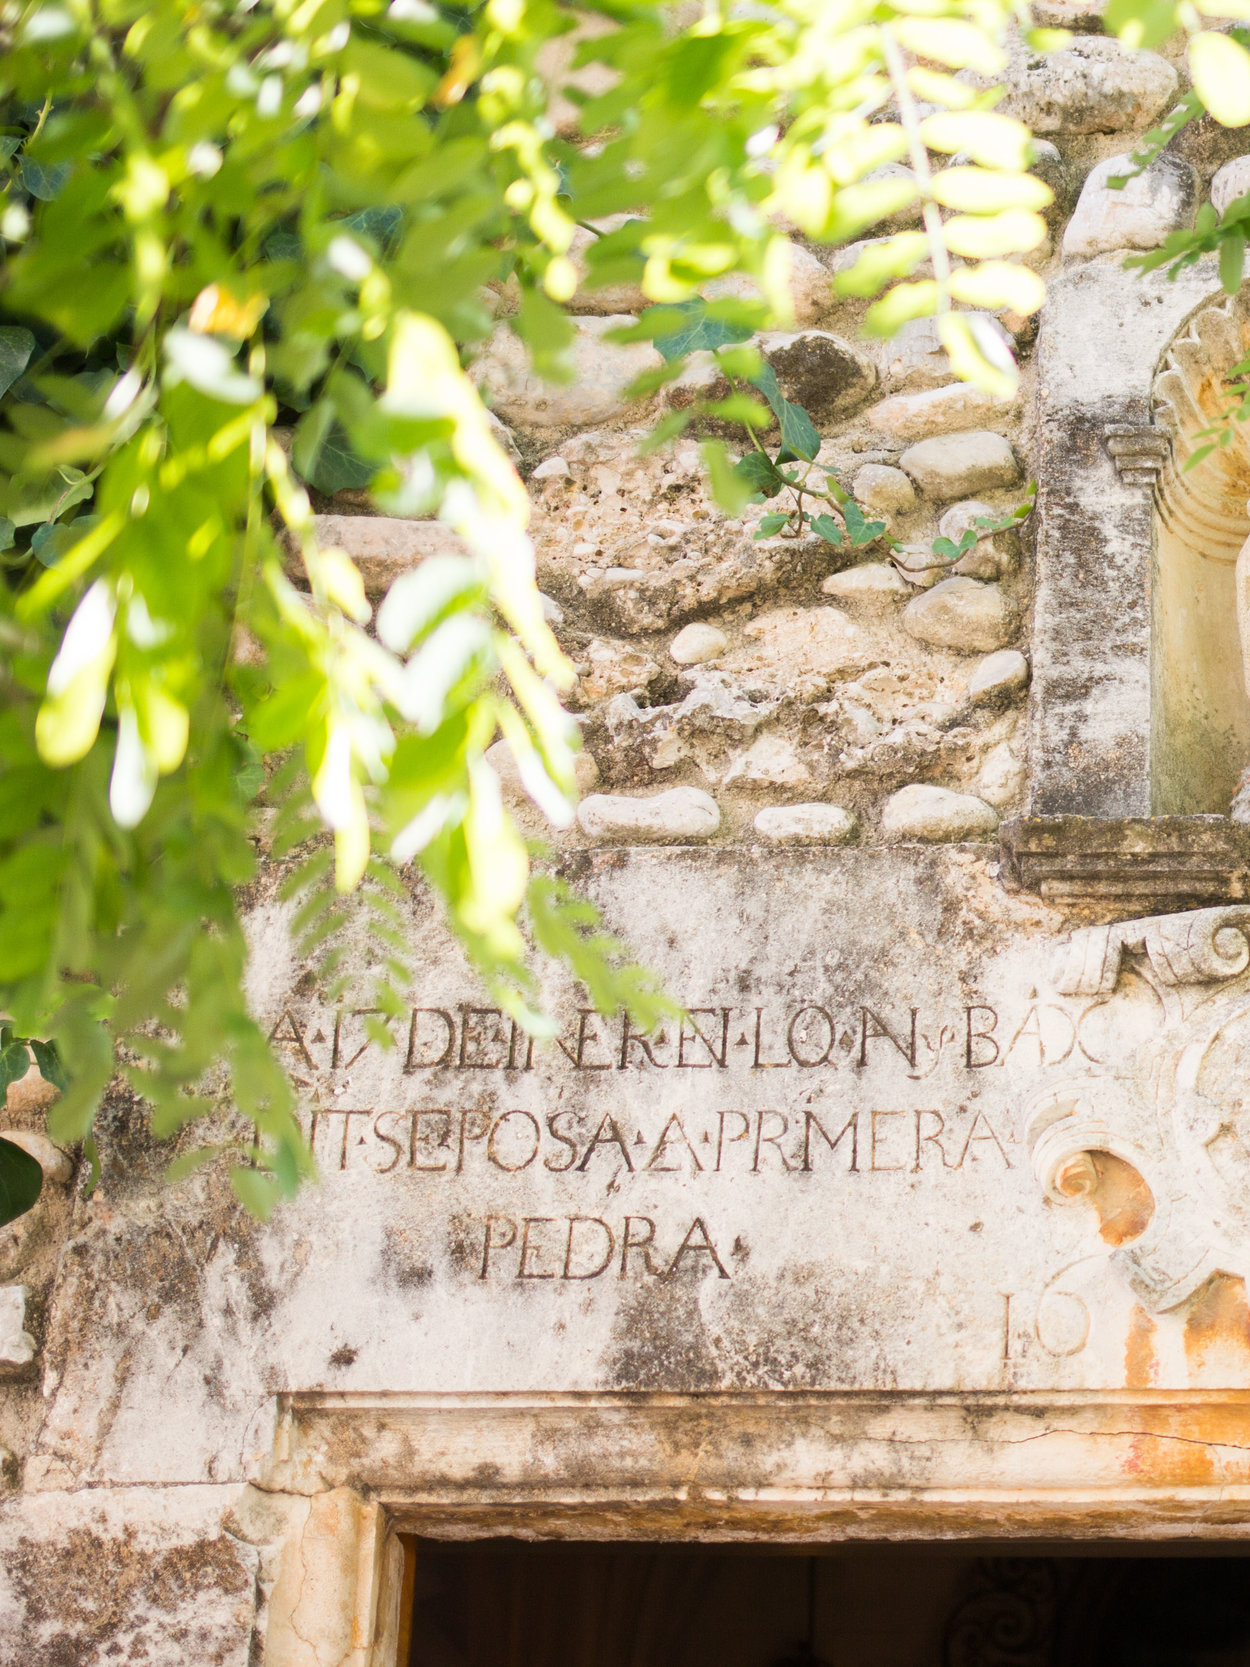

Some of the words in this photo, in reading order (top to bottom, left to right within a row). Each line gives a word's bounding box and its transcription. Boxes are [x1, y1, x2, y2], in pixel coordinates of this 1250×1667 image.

[402, 1003, 503, 1075] DE
[366, 1107, 449, 1174] SE
[450, 1107, 637, 1176] POSA
[477, 1212, 732, 1284] PEDRA
